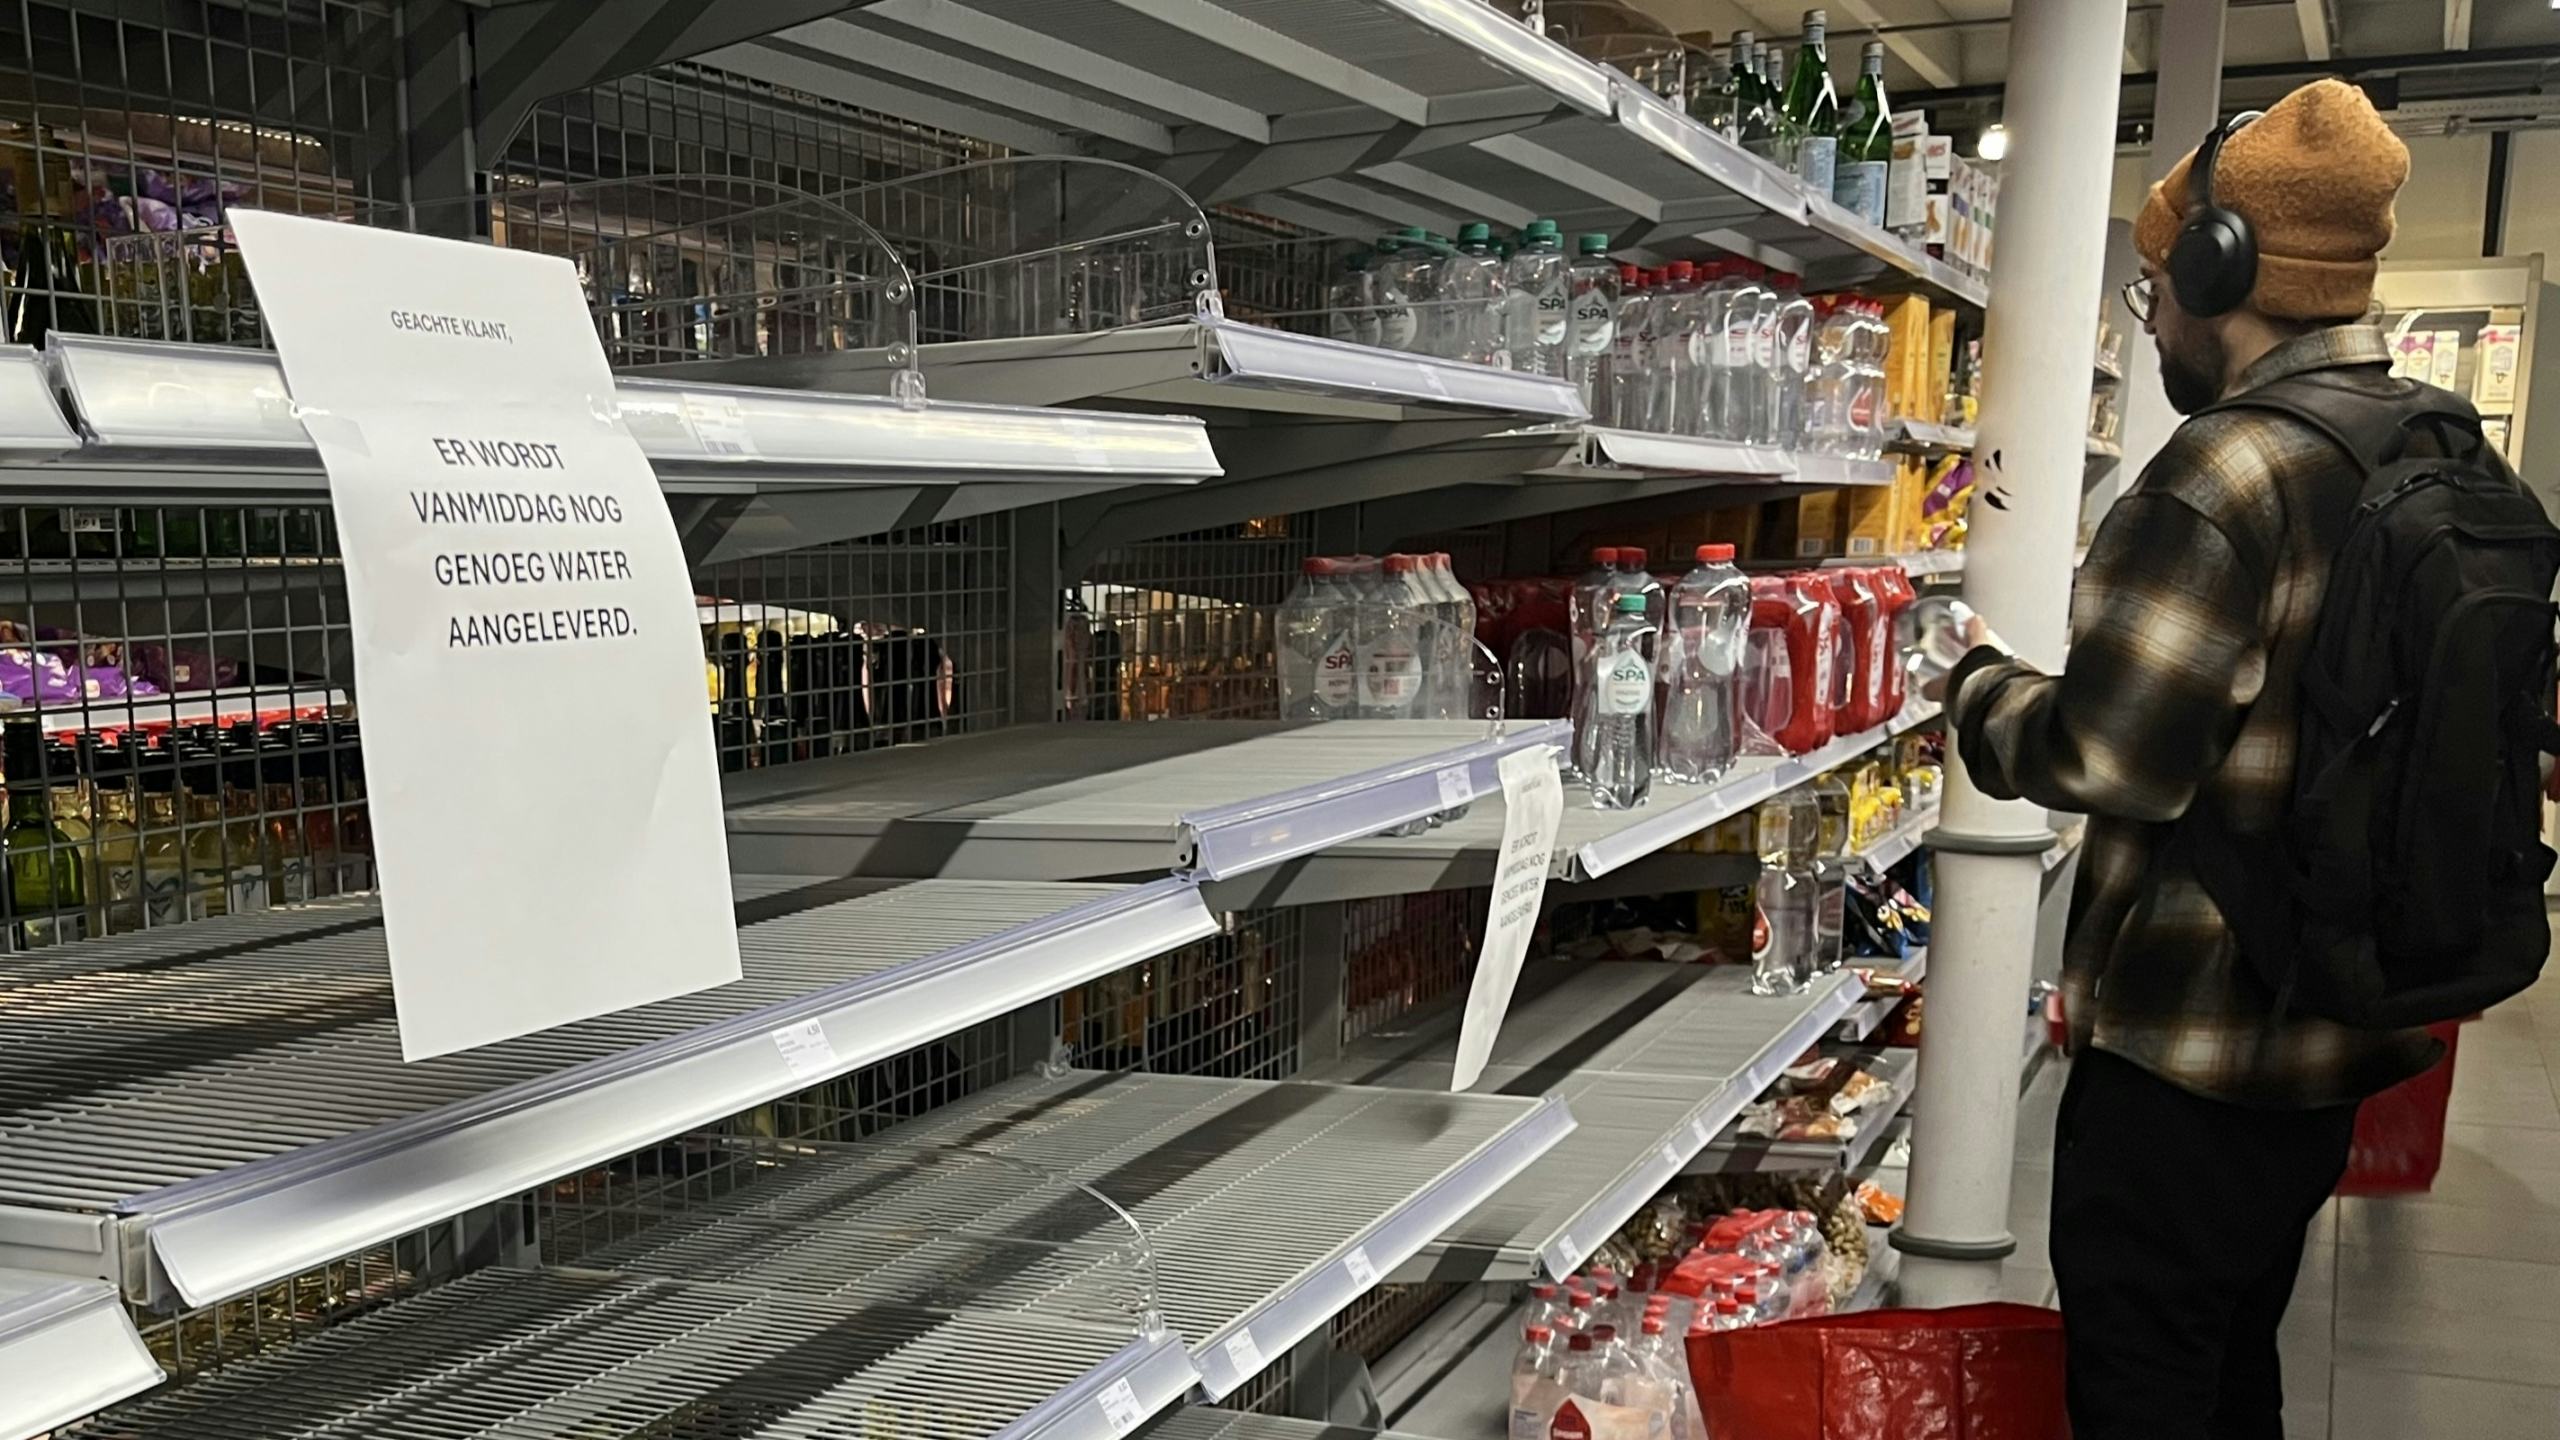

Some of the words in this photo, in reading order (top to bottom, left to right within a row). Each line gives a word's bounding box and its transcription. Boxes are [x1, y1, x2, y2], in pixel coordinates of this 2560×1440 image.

[390, 310, 461, 335] GEACHTE
[461, 318, 513, 344] KLANT,
[1577, 307, 1609, 320] SPA
[433, 438, 476, 467] ER
[469, 440, 565, 469] WORDT
[410, 491, 567, 523] VANMIDDAG
[568, 495, 623, 523] NOG
[434, 552, 545, 586] GENOEG
[548, 551, 632, 582] WATER
[449, 607, 638, 648] AANGELEVERD.
[1613, 670, 1646, 682] SPA
